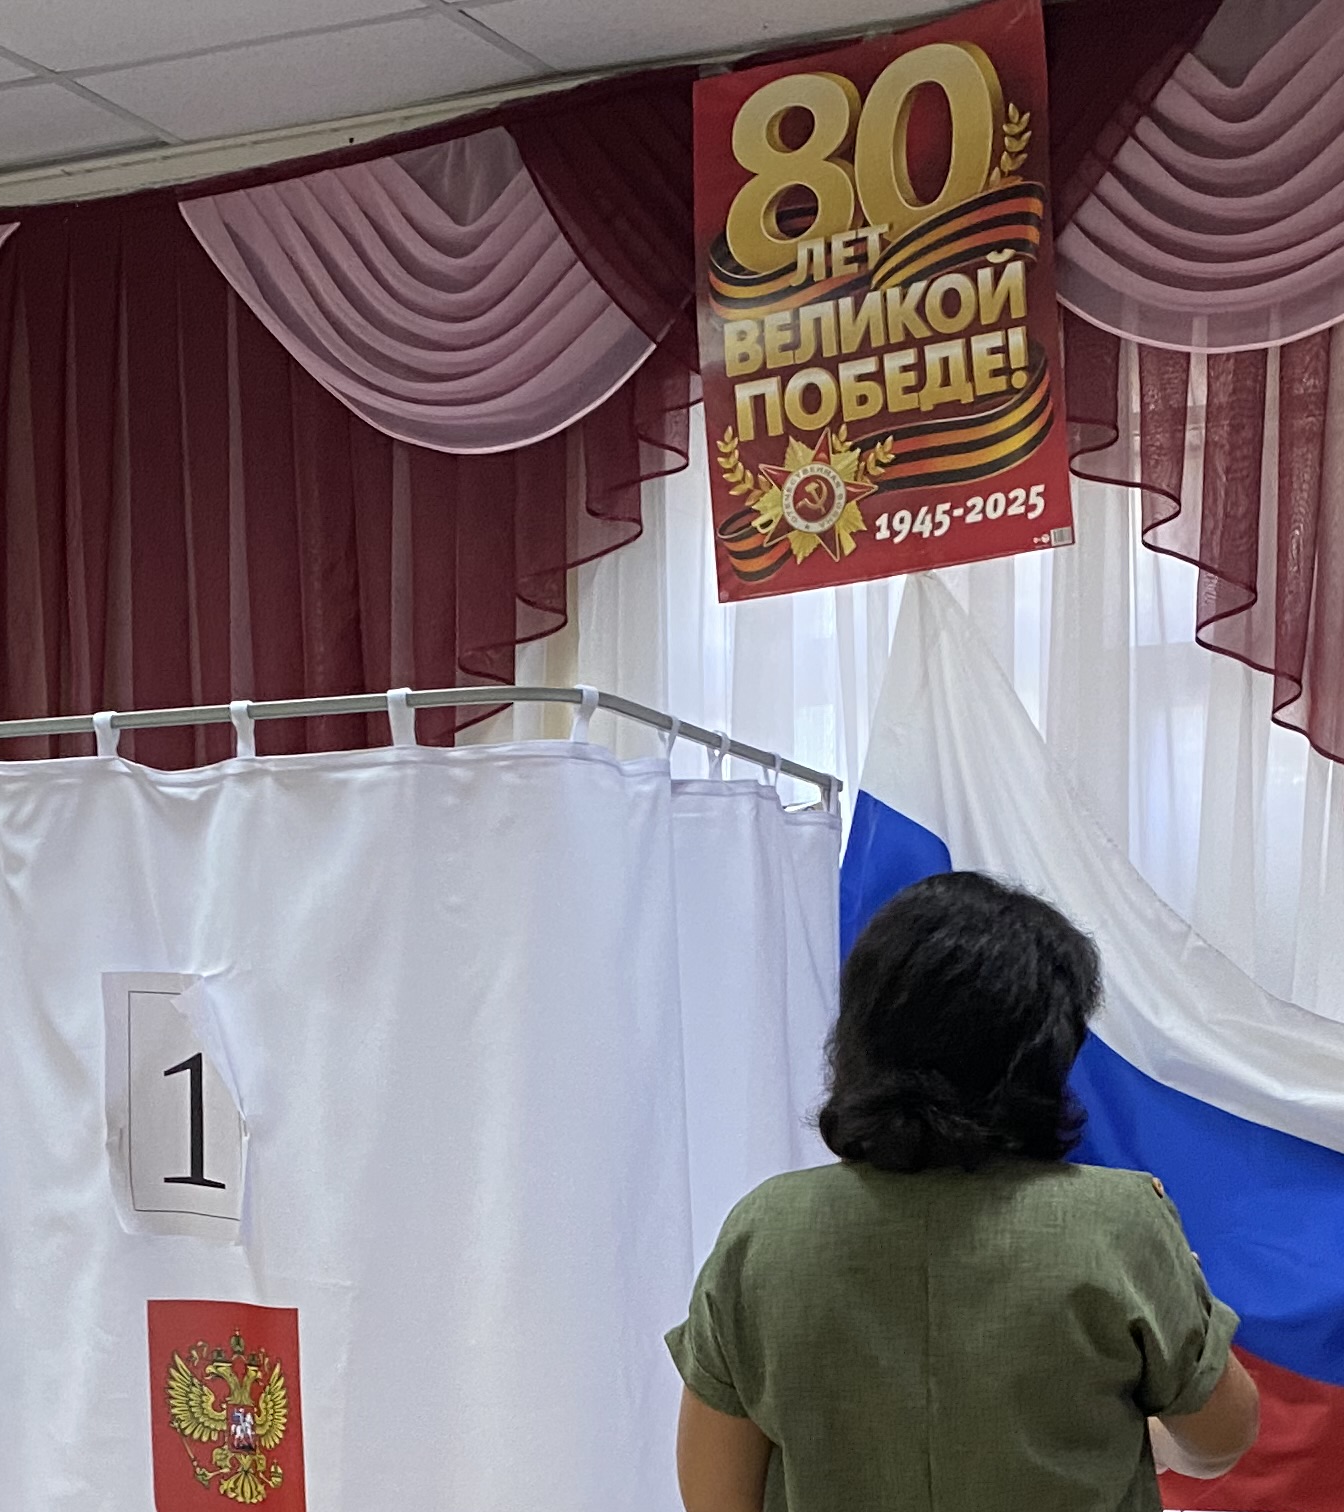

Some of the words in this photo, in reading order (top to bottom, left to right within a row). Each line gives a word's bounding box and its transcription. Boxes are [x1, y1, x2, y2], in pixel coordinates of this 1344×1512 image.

[725, 42, 1003, 274] 80
[723, 250, 1028, 378] ВЕЛИКОЙ
[789, 223, 891, 288] ЛЕТ
[734, 326, 1030, 442] ПОБЕДЕ!
[874, 485, 1046, 543] 1945-2025
[162, 1052, 227, 1189] 1
